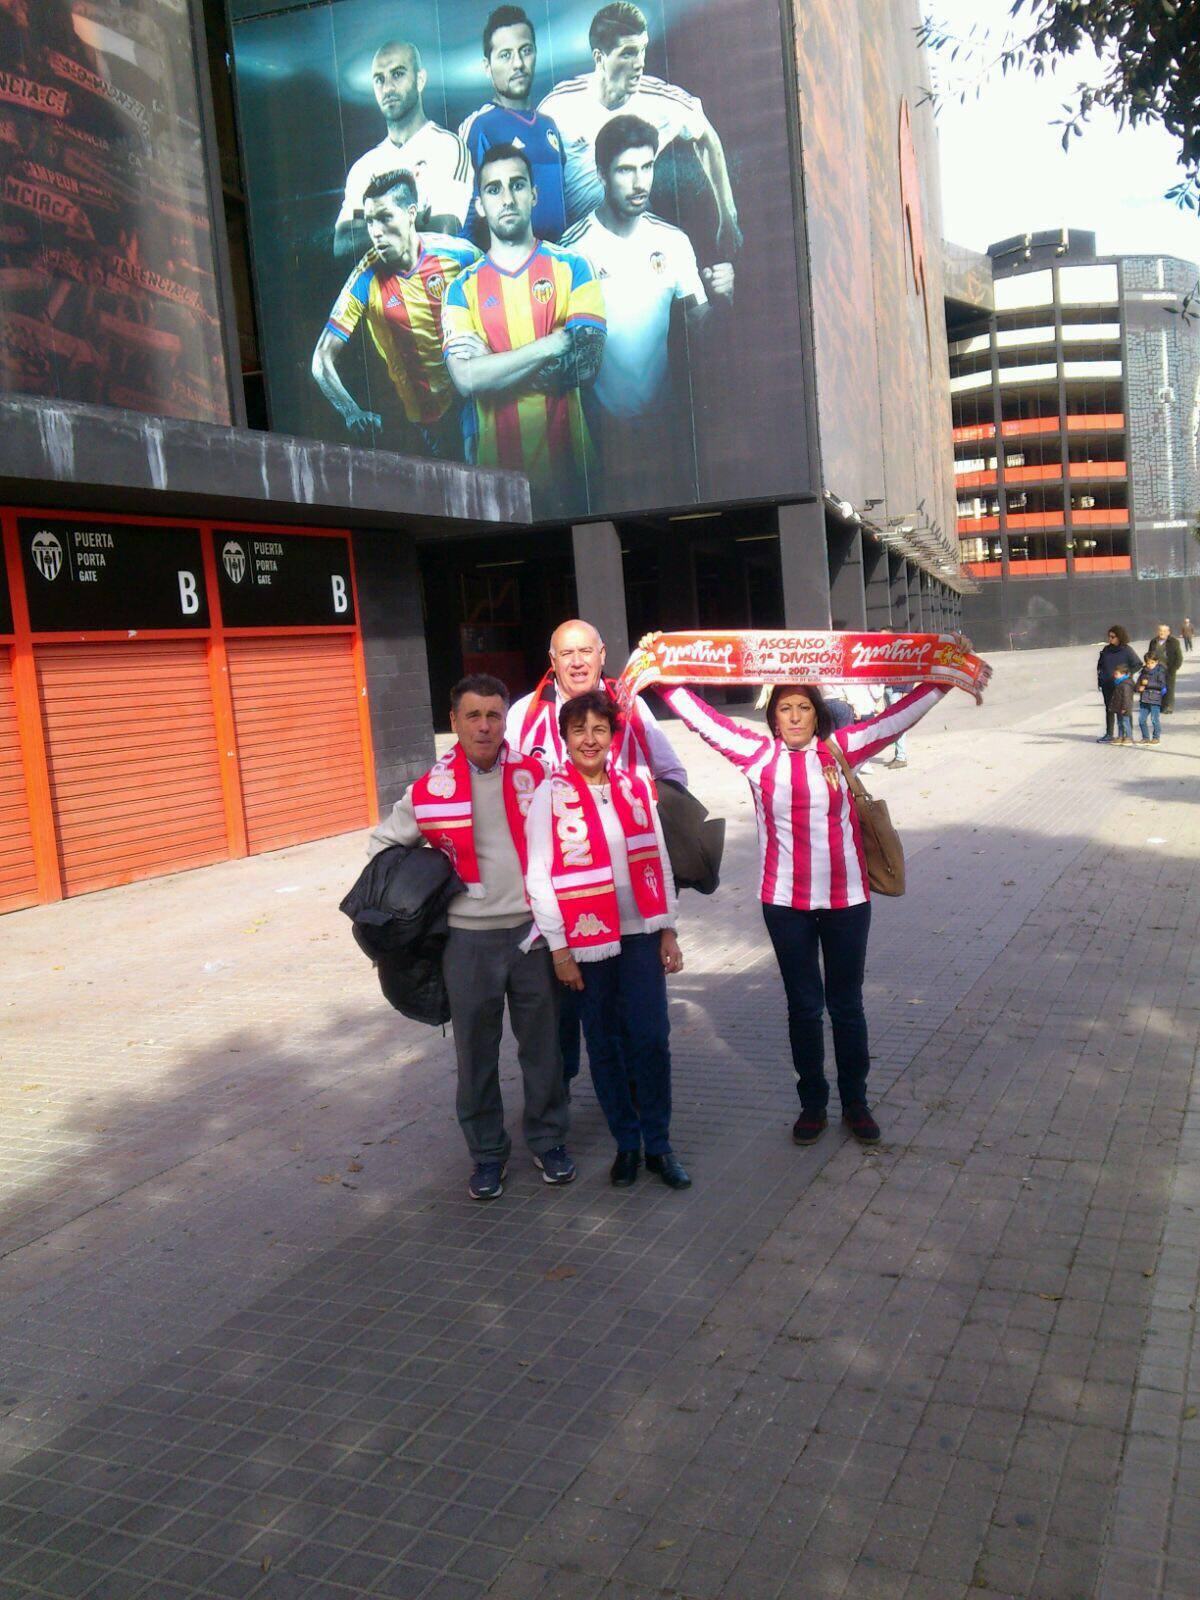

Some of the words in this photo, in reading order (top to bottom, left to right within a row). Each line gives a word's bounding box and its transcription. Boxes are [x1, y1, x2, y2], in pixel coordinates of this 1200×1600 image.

[74, 531, 114, 548] PUERTA
[254, 541, 284, 556] PUERTA
[77, 552, 106, 567] PORTA
[256, 559, 278, 571] PORTA
[79, 570, 98, 582] GATE
[257, 574, 272, 585] GATE
[178, 571, 199, 614] B
[331, 574, 348, 613] B
[759, 637, 825, 650] ASCENSO
[744, 651, 754, 664] A
[780, 650, 842, 664] DIVISIÓN
[788, 666, 810, 675] 2007
[818, 666, 842, 675] 2008
